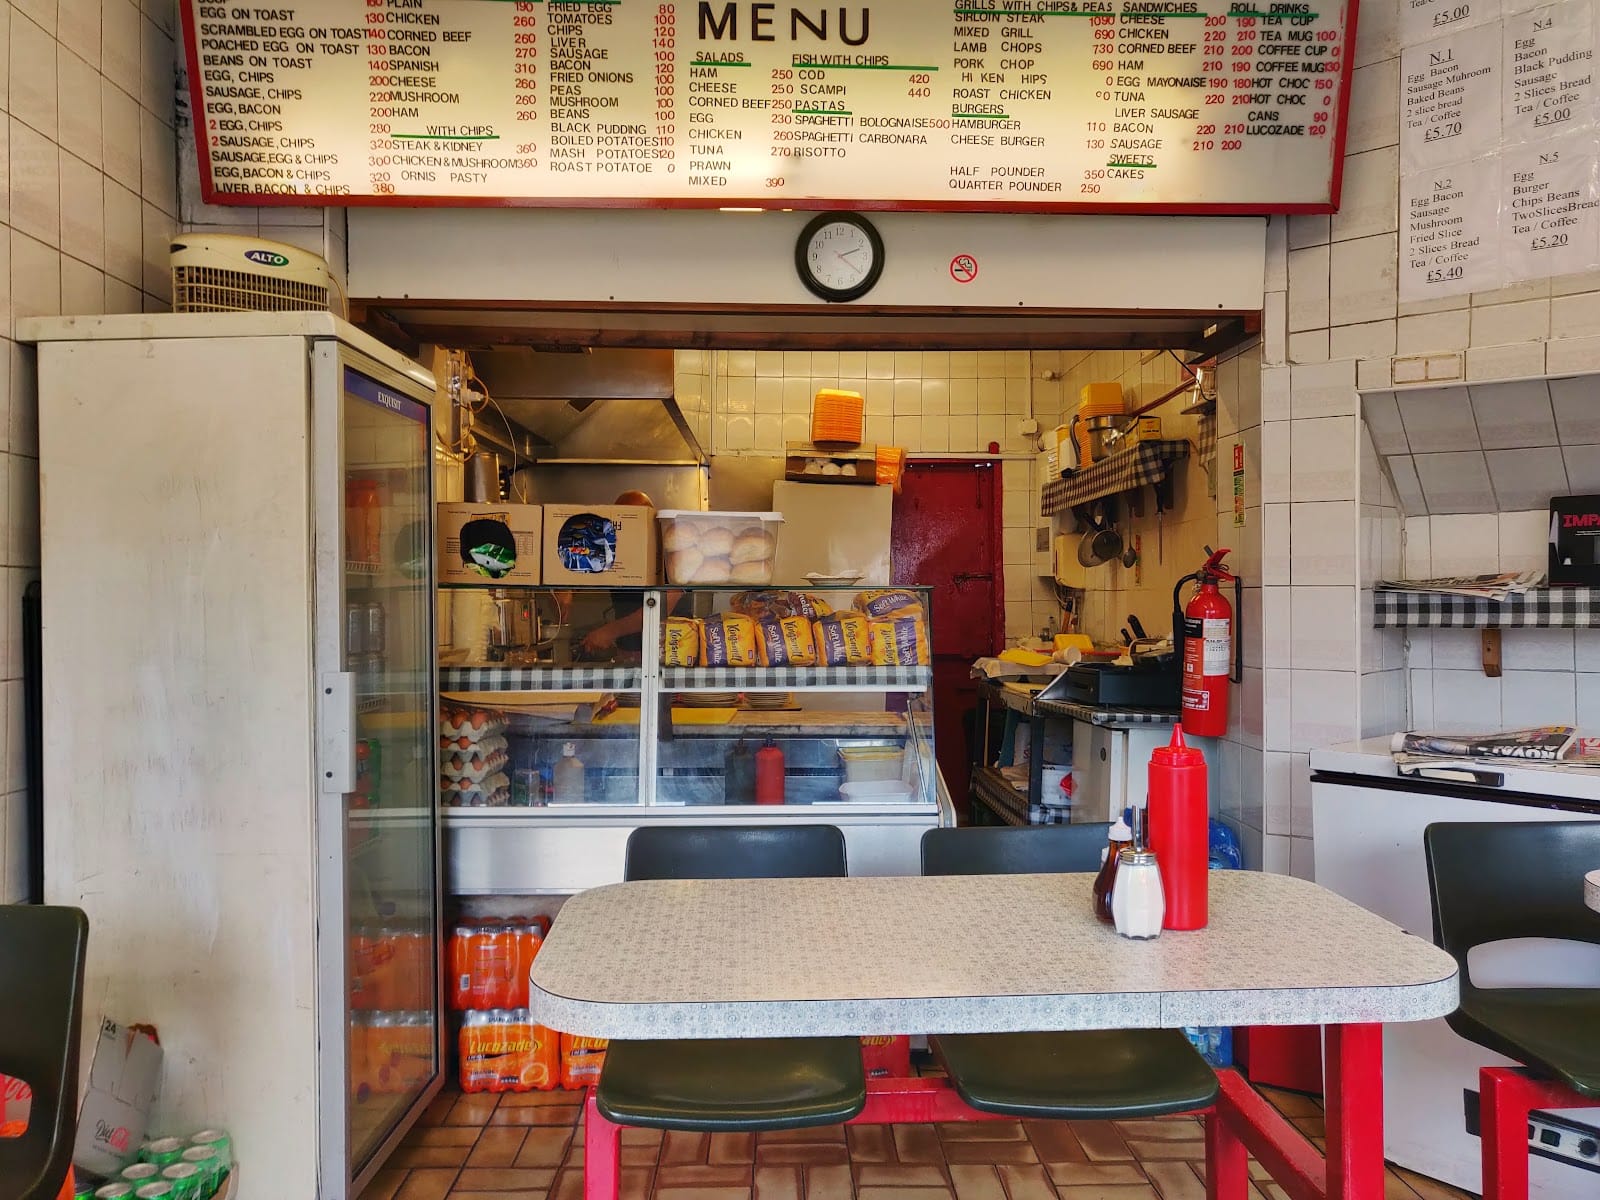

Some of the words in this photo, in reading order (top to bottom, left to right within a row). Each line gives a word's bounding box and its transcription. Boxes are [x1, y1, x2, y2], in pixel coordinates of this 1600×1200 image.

[588, 3, 612, 13] EGG
[955, 0, 995, 10] GRILLS
[1002, 1, 1031, 11] WITH
[1083, 1, 1113, 12] PEAS
[1123, 2, 1198, 13] SANDWICHES
[1270, 3, 1309, 14] DRINKS
[200, 7, 226, 20] EGG
[232, 8, 250, 20] ON
[253, 9, 295, 21] TOAST
[386, 12, 440, 25] CHICKEN
[513, 16, 536, 27] 260
[547, 13, 612, 25] TOMATOES
[654, 15, 675, 25] 100
[1120, 16, 1165, 25] CHEESE
[1433, 4, 1470, 25] £5.00
[699, 1, 869, 46] MENU
[201, 24, 277, 37] SCRAMBLED
[280, 27, 304, 38] EGG
[310, 28, 327, 39] ON
[387, 30, 437, 41] CORNED
[443, 31, 472, 42] BEEF
[547, 25, 583, 36] CHIPS
[654, 26, 675, 37] 120
[954, 27, 990, 38] MIXED
[1118, 28, 1168, 39] CHICKEN
[1237, 31, 1256, 41] 210
[1260, 31, 1282, 41] TEA
[1288, 31, 1313, 41] MUG
[201, 39, 259, 52] POACHED
[551, 37, 586, 48] LIVER
[954, 42, 987, 53] LAMB
[1001, 42, 1042, 53] CHOPS
[1118, 43, 1165, 54] CORNED
[1168, 44, 1197, 54] BEEF
[1515, 38, 1536, 50] Egg
[389, 45, 430, 56] BACON
[550, 49, 608, 60] SAUSAGE
[696, 51, 744, 62] SALADS
[1258, 45, 1301, 56] COFFEE
[1305, 46, 1328, 56] CUP
[1514, 48, 1548, 62] Bacon
[203, 55, 244, 66] BEANS
[249, 56, 267, 67] ON
[273, 57, 313, 69] TOAST
[954, 58, 984, 69] PORK
[1000, 59, 1035, 70] CHOP
[1118, 61, 1144, 71] HAM
[1203, 61, 1223, 71] 210
[1256, 61, 1298, 72] COFFEE
[1515, 60, 1545, 75] Black
[1549, 49, 1593, 67] Pudding
[798, 70, 825, 80] COD
[909, 74, 930, 84] 420
[1407, 73, 1425, 84] Egg
[1430, 64, 1459, 77] Bacon
[1407, 80, 1443, 95] Sausage
[1446, 66, 1491, 85] Muhroom
[1514, 72, 1558, 89] Sausage
[550, 85, 582, 96] PEAS
[1524, 85, 1556, 100] Slices
[1560, 75, 1591, 91] Bread
[550, 96, 619, 108] MUSHROOM
[689, 96, 739, 108] CORNED
[1114, 92, 1145, 102] TUNA
[1277, 94, 1306, 105] CHOC
[1407, 92, 1435, 106] Baked
[1438, 86, 1465, 99] Beans
[795, 100, 845, 111] PASTAS
[952, 103, 1004, 114] BURGERS
[1415, 105, 1436, 116] slice
[1437, 96, 1463, 110] bread
[1514, 104, 1533, 115] Tea
[1543, 92, 1580, 108] Coffee
[550, 108, 590, 119] BEANS
[689, 113, 714, 123] EGG
[771, 114, 792, 124] 230
[1407, 119, 1423, 129] Tea
[1430, 109, 1461, 124] Coffee
[1534, 107, 1571, 125] £5.00
[426, 125, 456, 136] WITH
[460, 125, 494, 136] CHIPS
[551, 122, 591, 133] BLACK
[597, 124, 647, 135] PUDDING
[689, 128, 742, 140] CHICKEN
[1246, 125, 1305, 136] LUCOZADE
[1424, 121, 1462, 141] £5.70
[551, 136, 594, 146] BOILED
[794, 131, 854, 143] SPAGHETTI
[859, 133, 928, 145] CARBONARA
[550, 148, 585, 158] MASH
[689, 144, 724, 155] TUNA
[794, 147, 846, 158] RISOTTO
[1109, 154, 1154, 165] SWEETS
[550, 162, 593, 173] ROAST
[597, 162, 653, 173] POTATOE
[1107, 168, 1145, 180] CAKES
[1513, 172, 1535, 183] Egg
[949, 178, 1003, 190] QUARTER
[1009, 181, 1062, 192] POUNDER
[1513, 182, 1550, 195] Burger
[1410, 198, 1430, 208] Egg
[1432, 191, 1464, 203] Bacon
[1512, 197, 1543, 209] Chips
[1547, 189, 1581, 202] Beans
[1410, 206, 1450, 220] Sausage
[1410, 216, 1463, 232] Mushroom
[1512, 225, 1530, 234] Tea
[1541, 217, 1578, 230] Coffee
[1410, 231, 1435, 244] Fried
[1437, 228, 1462, 240] Slice
[1531, 233, 1569, 249] £5.20
[1418, 243, 1447, 255] Slices
[1450, 236, 1480, 250] Bread
[250, 252, 284, 265] ALTO
[1410, 259, 1426, 269] Tea
[1435, 252, 1469, 265] Coffee
[1427, 266, 1463, 281] £5.40
[1563, 514, 1600, 528] IMP
[710, 627, 721, 643] Soft
[768, 625, 780, 641] Soft
[829, 624, 840, 641] Soft
[727, 623, 743, 662] Kingsmill
[784, 621, 804, 658] Kingsmill
[845, 621, 862, 658] Kingsmill
[714, 641, 722, 665] White
[773, 639, 783, 664] White
[833, 639, 844, 662] White
[105, 1020, 117, 1034] 24
